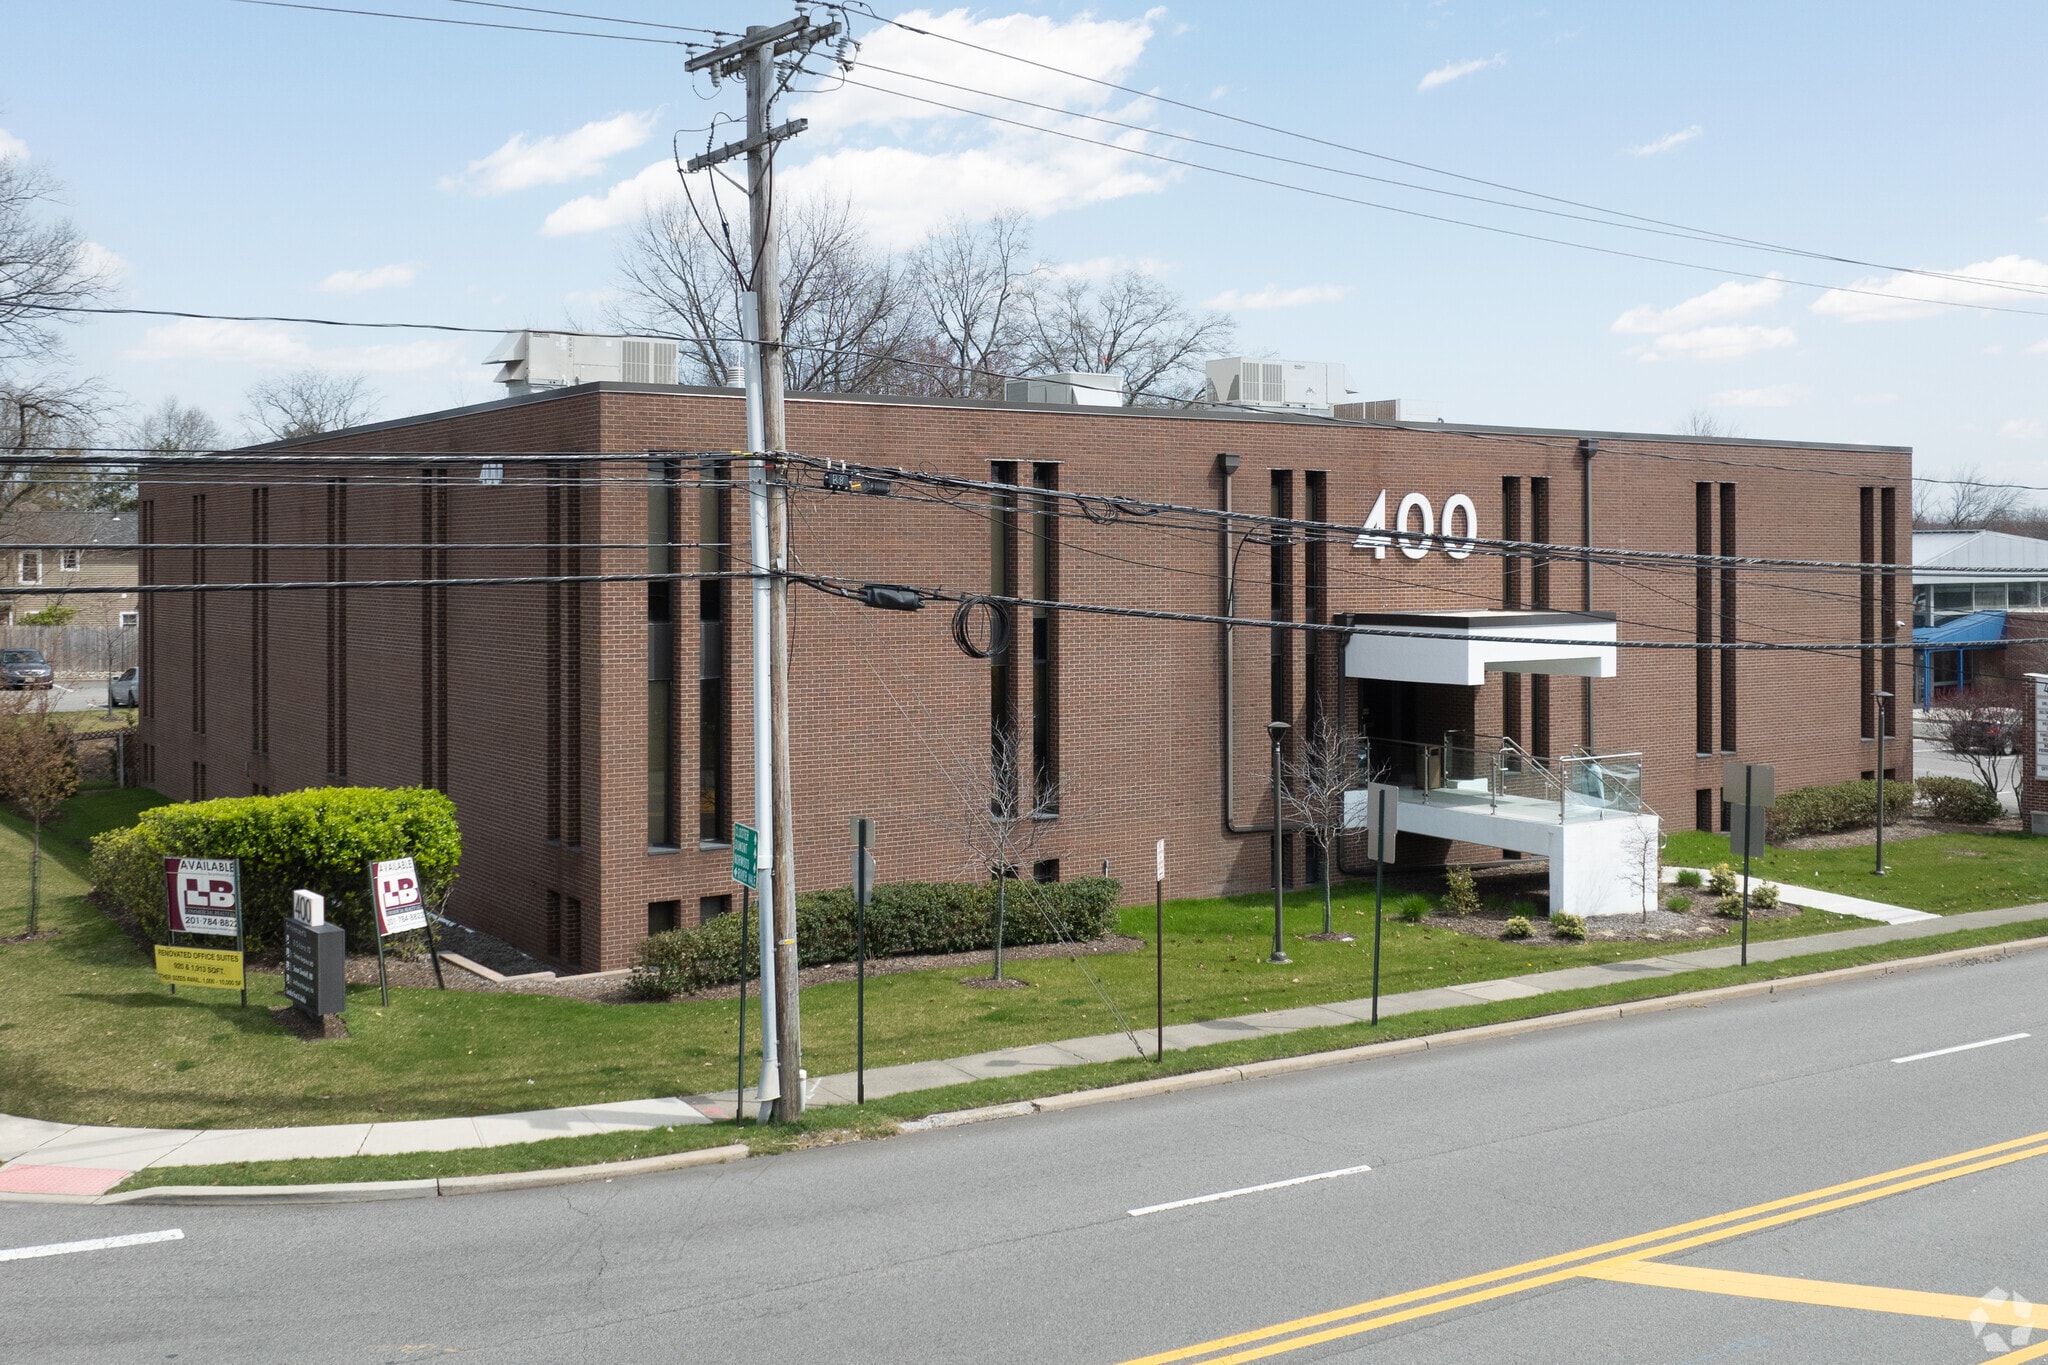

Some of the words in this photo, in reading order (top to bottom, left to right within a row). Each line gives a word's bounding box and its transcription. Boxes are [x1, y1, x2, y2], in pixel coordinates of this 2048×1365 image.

[479, 463, 503, 485] 400
[1352, 488, 1478, 560] 400
[735, 839, 748, 854] DUMONT
[180, 860, 234, 872] AVAILABLE
[380, 859, 412, 872] AVAILABLE
[734, 853, 750, 870] NORWOOD
[294, 895, 312, 924] 400
[158, 949, 191, 959] RENOVATED
[193, 952, 215, 960] OFFICE
[216, 954, 239, 962] SUITES
